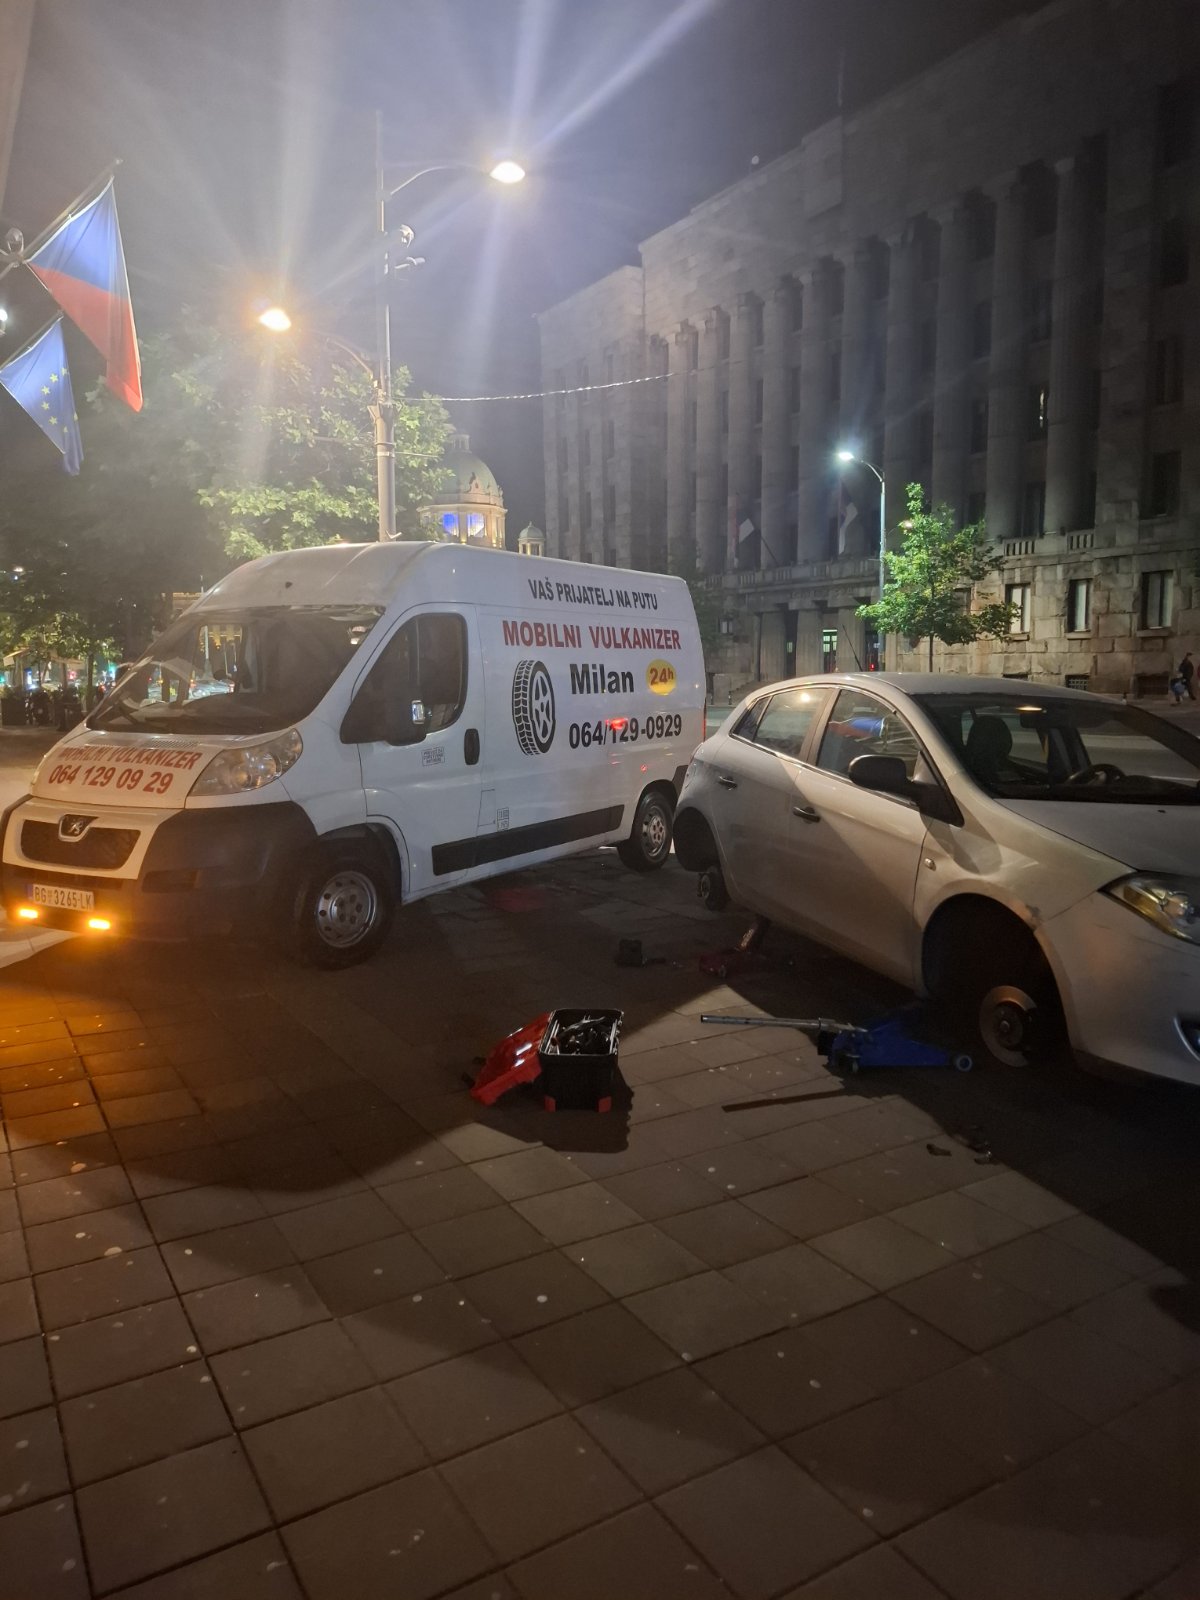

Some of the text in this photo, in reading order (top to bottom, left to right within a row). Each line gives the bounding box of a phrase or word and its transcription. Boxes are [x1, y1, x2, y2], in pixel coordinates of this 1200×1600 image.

[528, 577, 658, 610] VAŠ PRIJATELJ NA PUTU
[502, 620, 682, 650] MOBILNI VULKANIZER
[569, 663, 635, 695] Milan
[649, 669, 674, 686] 24h
[569, 713, 682, 749] 064/129-0929
[107, 748, 202, 770] VULKANIZER
[48, 764, 174, 794] 064 129 09 29
